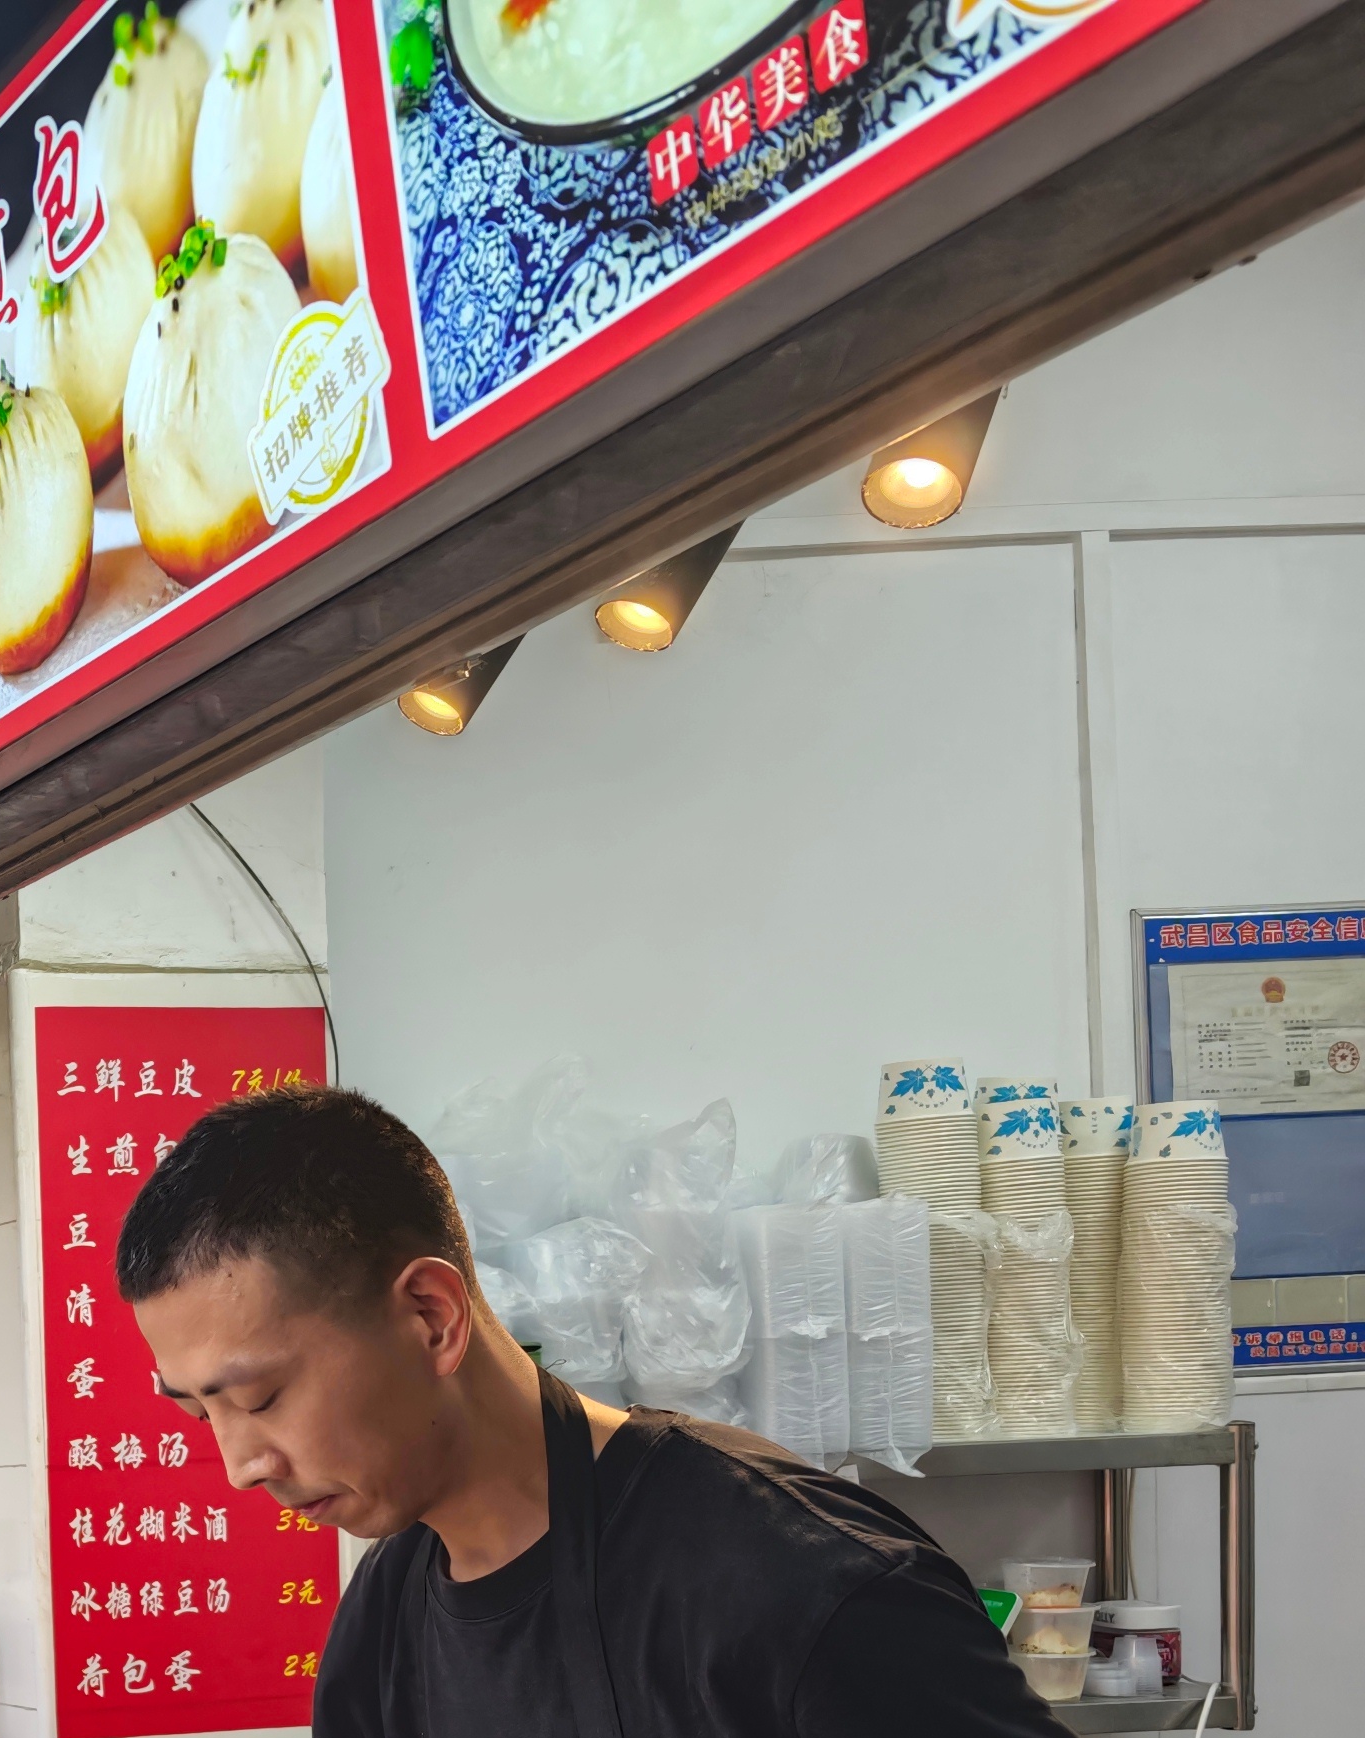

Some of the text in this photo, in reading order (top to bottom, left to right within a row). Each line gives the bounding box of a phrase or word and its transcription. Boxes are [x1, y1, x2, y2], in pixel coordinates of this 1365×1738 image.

[654, 8, 864, 191] 中华美食
[262, 334, 370, 483] 招牌推荐
[55, 1058, 203, 1103] 三鲜豆皮
[67, 1432, 190, 1472] 酸梅汤
[68, 1502, 320, 1548] 桂花糊米酒 3元
[69, 1577, 323, 1623] 冰糖绿豆汤 3元
[76, 1649, 319, 1698] 荷包蛋 2元
